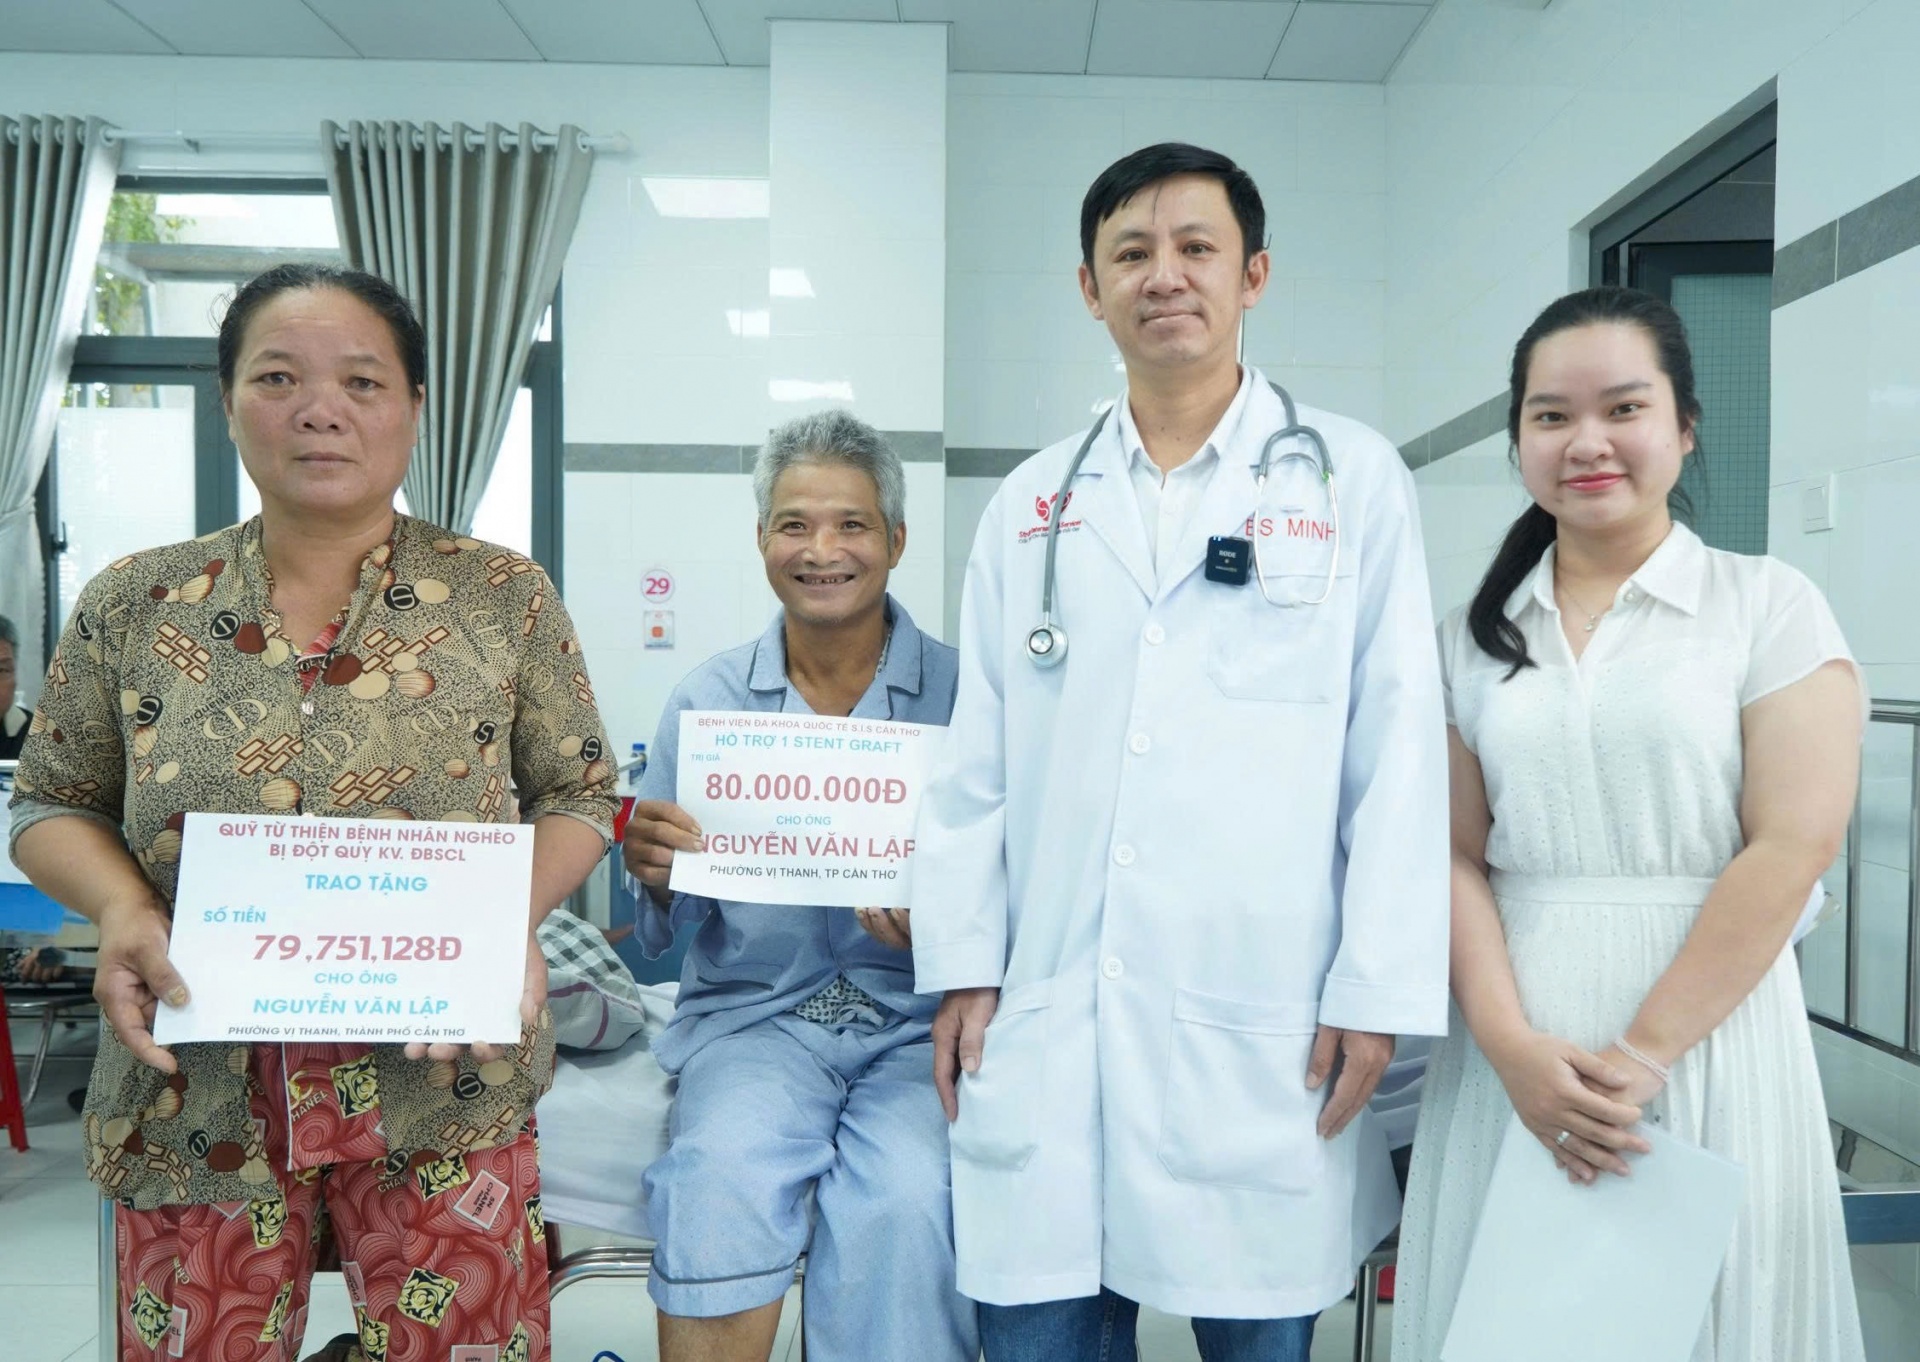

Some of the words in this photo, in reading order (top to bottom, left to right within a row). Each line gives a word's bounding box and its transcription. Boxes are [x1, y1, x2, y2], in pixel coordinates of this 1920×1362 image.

[1287, 518, 1335, 541] MINH
[646, 577, 670, 595] 29
[771, 719, 800, 729] KHOA
[742, 734, 777, 750] TRỢ
[782, 735, 788, 747] 1
[794, 735, 844, 750] STENT
[849, 739, 902, 753] GRAFT
[705, 773, 907, 804] 80.000.000Đ
[776, 815, 802, 825] CHO
[805, 813, 832, 826] ÔNG
[219, 820, 258, 838] QUỸ
[264, 820, 286, 838] TỪ
[290, 823, 340, 843] THIỆN
[346, 824, 391, 844] BỆNH
[398, 826, 448, 842] NHÂN
[454, 828, 516, 845] NGHÈO
[269, 843, 286, 860] BỊ
[292, 841, 329, 861] ĐỘT
[335, 845, 372, 862] QUỴ
[379, 846, 404, 860] KV.
[411, 847, 466, 861] ĐBSCL
[805, 831, 858, 857] VĂN
[868, 835, 916, 863] LẬP
[709, 864, 763, 877] PHƯỜNG
[766, 867, 776, 879] VỊ
[780, 867, 821, 879] THANH,
[825, 868, 840, 878] TP
[872, 869, 898, 880] THƠ
[305, 874, 361, 891] TRAO
[369, 872, 428, 895] TẶNG
[203, 905, 229, 923] SỐ
[314, 973, 354, 984] CHO
[359, 970, 398, 984] ÔNG
[253, 992, 347, 1014] NGUYỄN
[355, 996, 401, 1014] VĂN
[409, 996, 449, 1019] LẬP
[228, 1024, 280, 1035] PHƯỜNG
[284, 1027, 295, 1037] VỊ
[299, 1027, 341, 1037] THANH,
[345, 1025, 383, 1036] THÀNH
[387, 1025, 412, 1036] PHỐ
[443, 1027, 466, 1037] THƠ
[291, 1090, 328, 1122] HANEL
[472, 1181, 494, 1217] CHANEL
